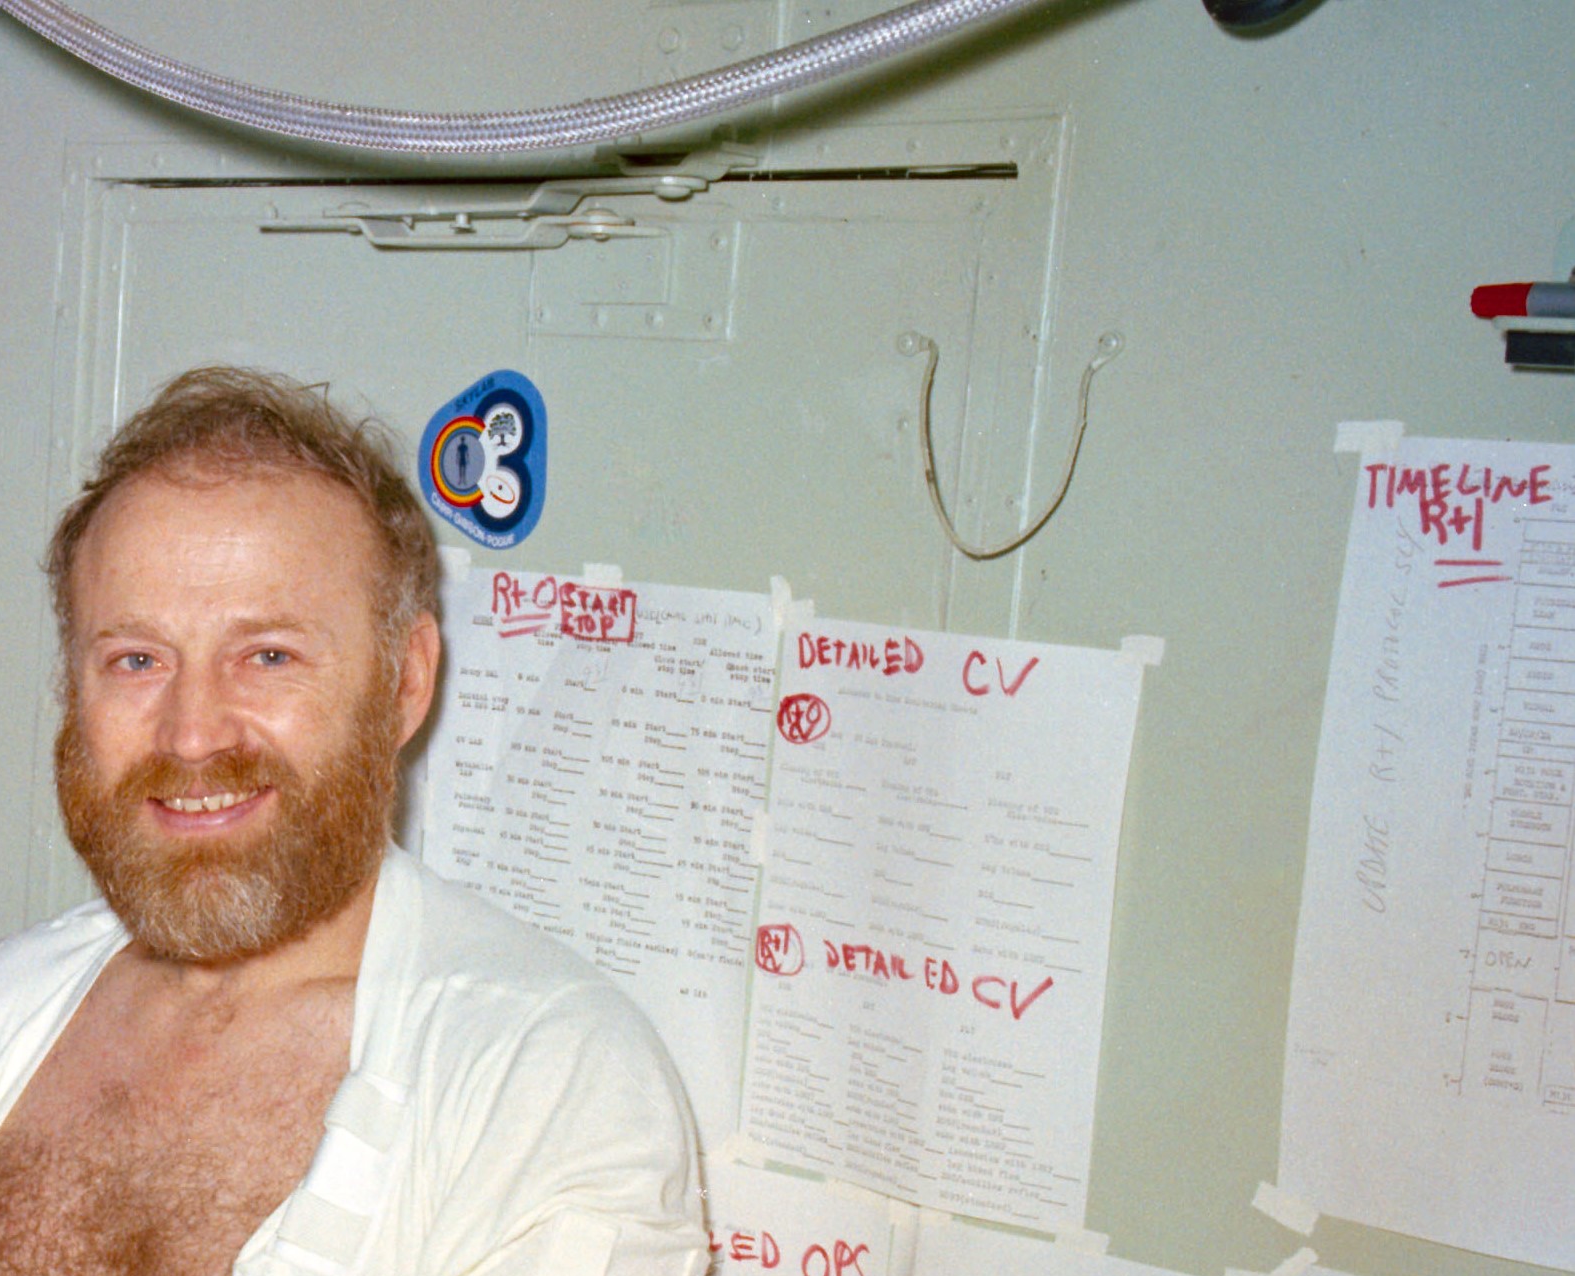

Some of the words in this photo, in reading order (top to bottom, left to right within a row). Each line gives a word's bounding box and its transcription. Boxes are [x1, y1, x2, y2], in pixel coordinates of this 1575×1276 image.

[1365, 463, 1552, 509] TIMELINE
[1420, 497, 1485, 551] R+1
[563, 582, 630, 617] START
[562, 610, 615, 640] STOP
[798, 631, 925, 677] DETAILED
[963, 649, 1040, 697] CV
[1484, 950, 1532, 969] OPEN
[971, 975, 1054, 1021] CV
